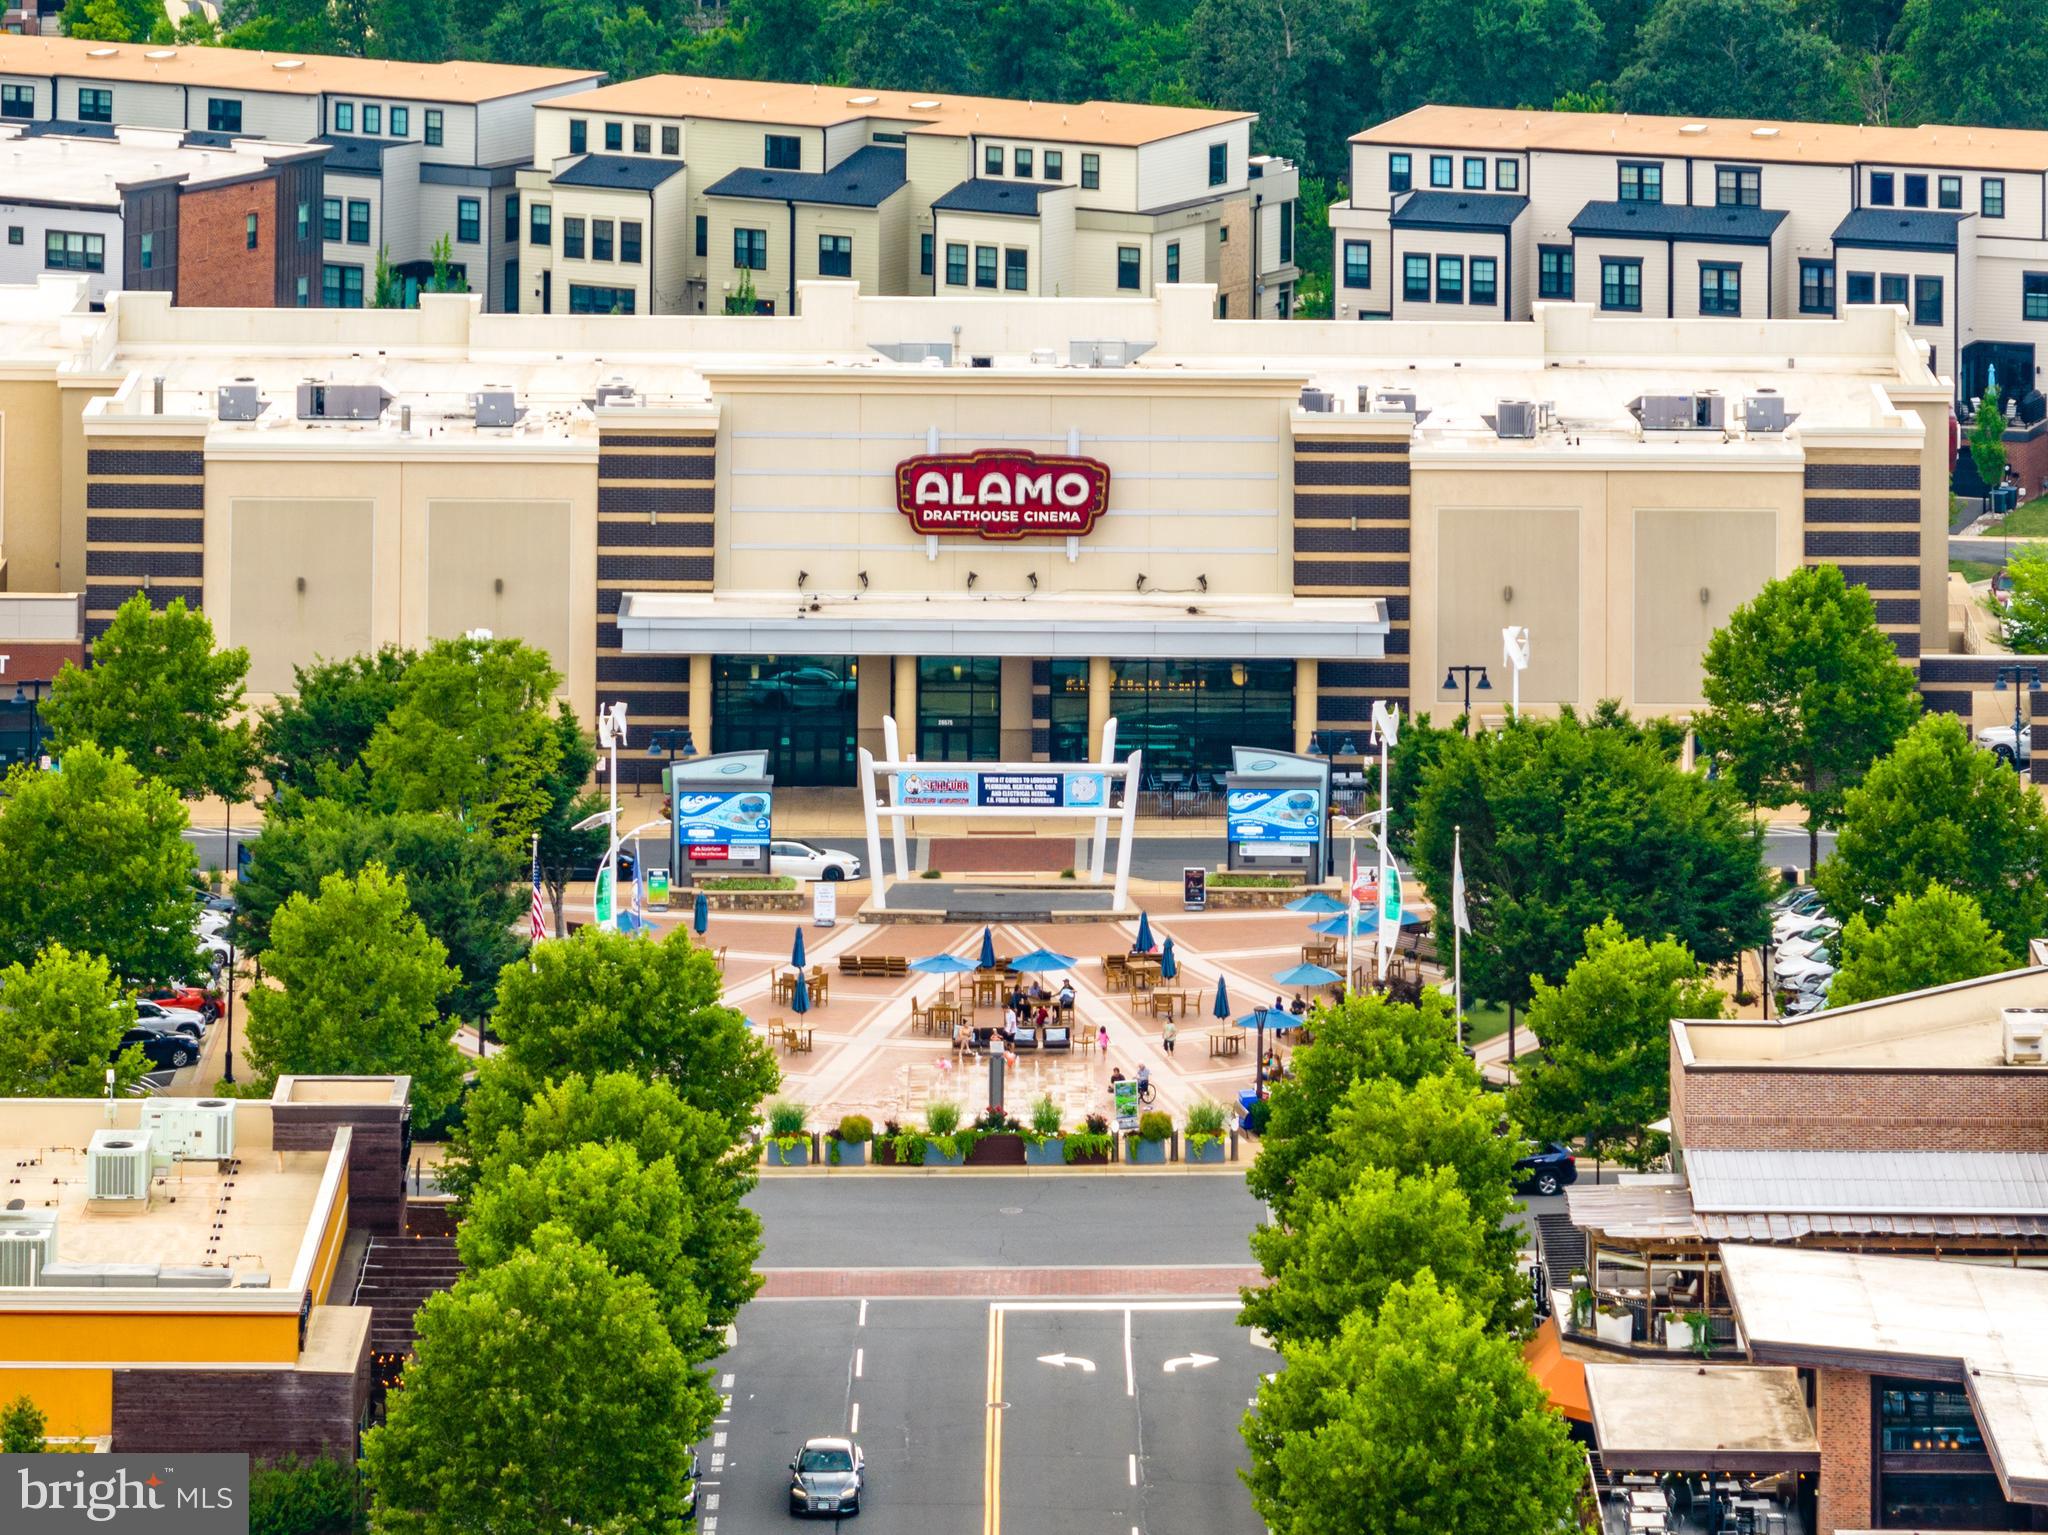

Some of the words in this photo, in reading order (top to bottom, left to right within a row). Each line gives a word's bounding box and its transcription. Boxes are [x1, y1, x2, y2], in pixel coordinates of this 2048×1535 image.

[915, 471, 1090, 506] ALAMO
[923, 510, 1019, 521] DRAFTHOUSE
[1023, 511, 1081, 522] CINEMA
